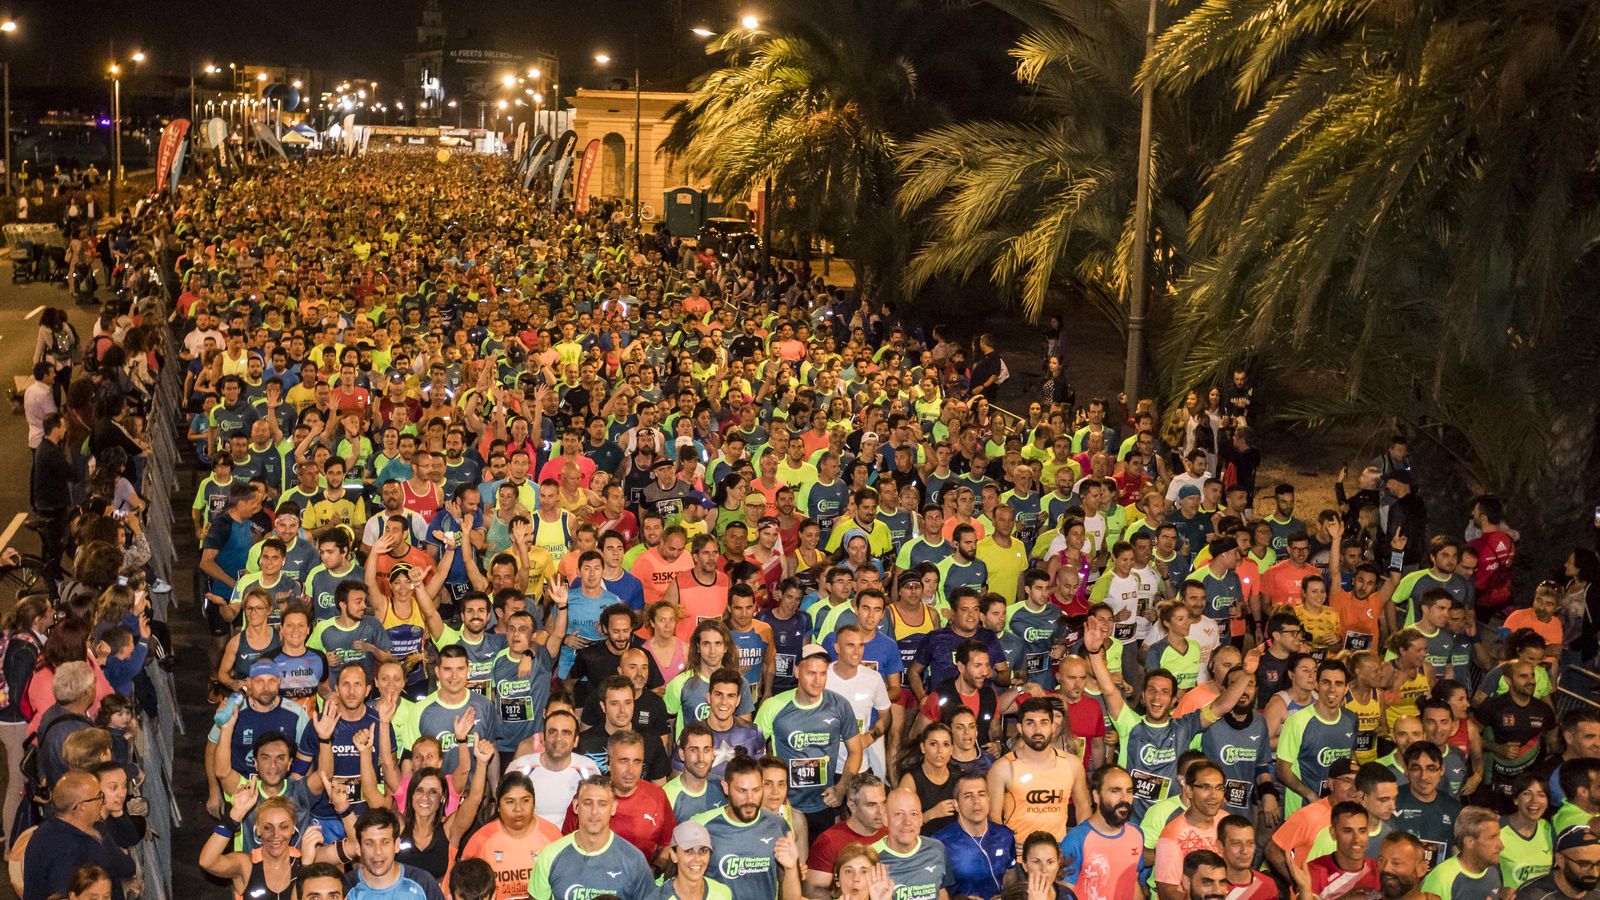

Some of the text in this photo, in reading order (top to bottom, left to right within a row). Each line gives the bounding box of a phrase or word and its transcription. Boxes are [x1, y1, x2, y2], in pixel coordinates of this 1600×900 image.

[652, 572, 674, 582] 515K
[290, 667, 314, 677] rehab
[797, 768, 815, 777] 4576
[1136, 780, 1155, 792] 3447
[1230, 788, 1244, 799] 5522
[1027, 805, 1061, 814] induction
